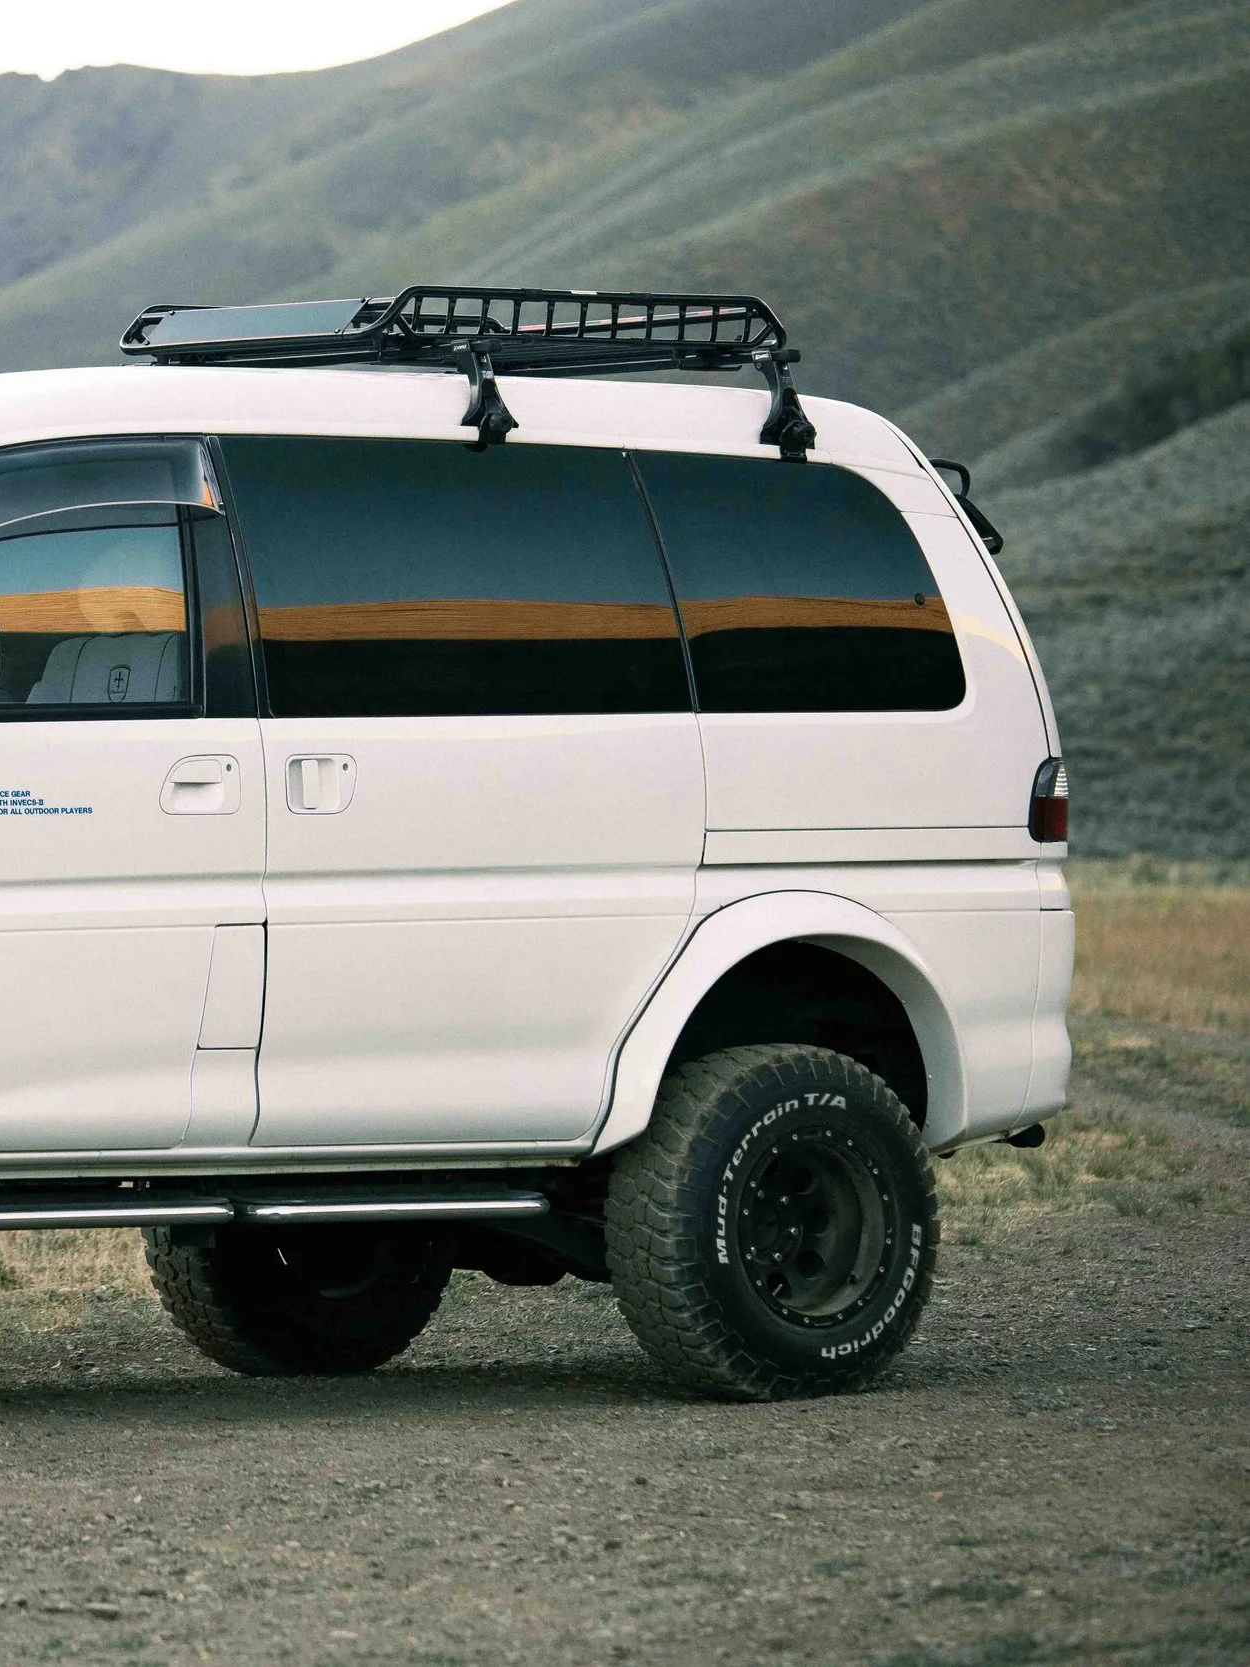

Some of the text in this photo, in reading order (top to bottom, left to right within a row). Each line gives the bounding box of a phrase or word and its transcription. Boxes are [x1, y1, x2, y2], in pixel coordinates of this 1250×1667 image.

[715, 1093, 847, 1264] Mud-Terrain T/A
[821, 1223, 922, 1360] BFGoodrich
